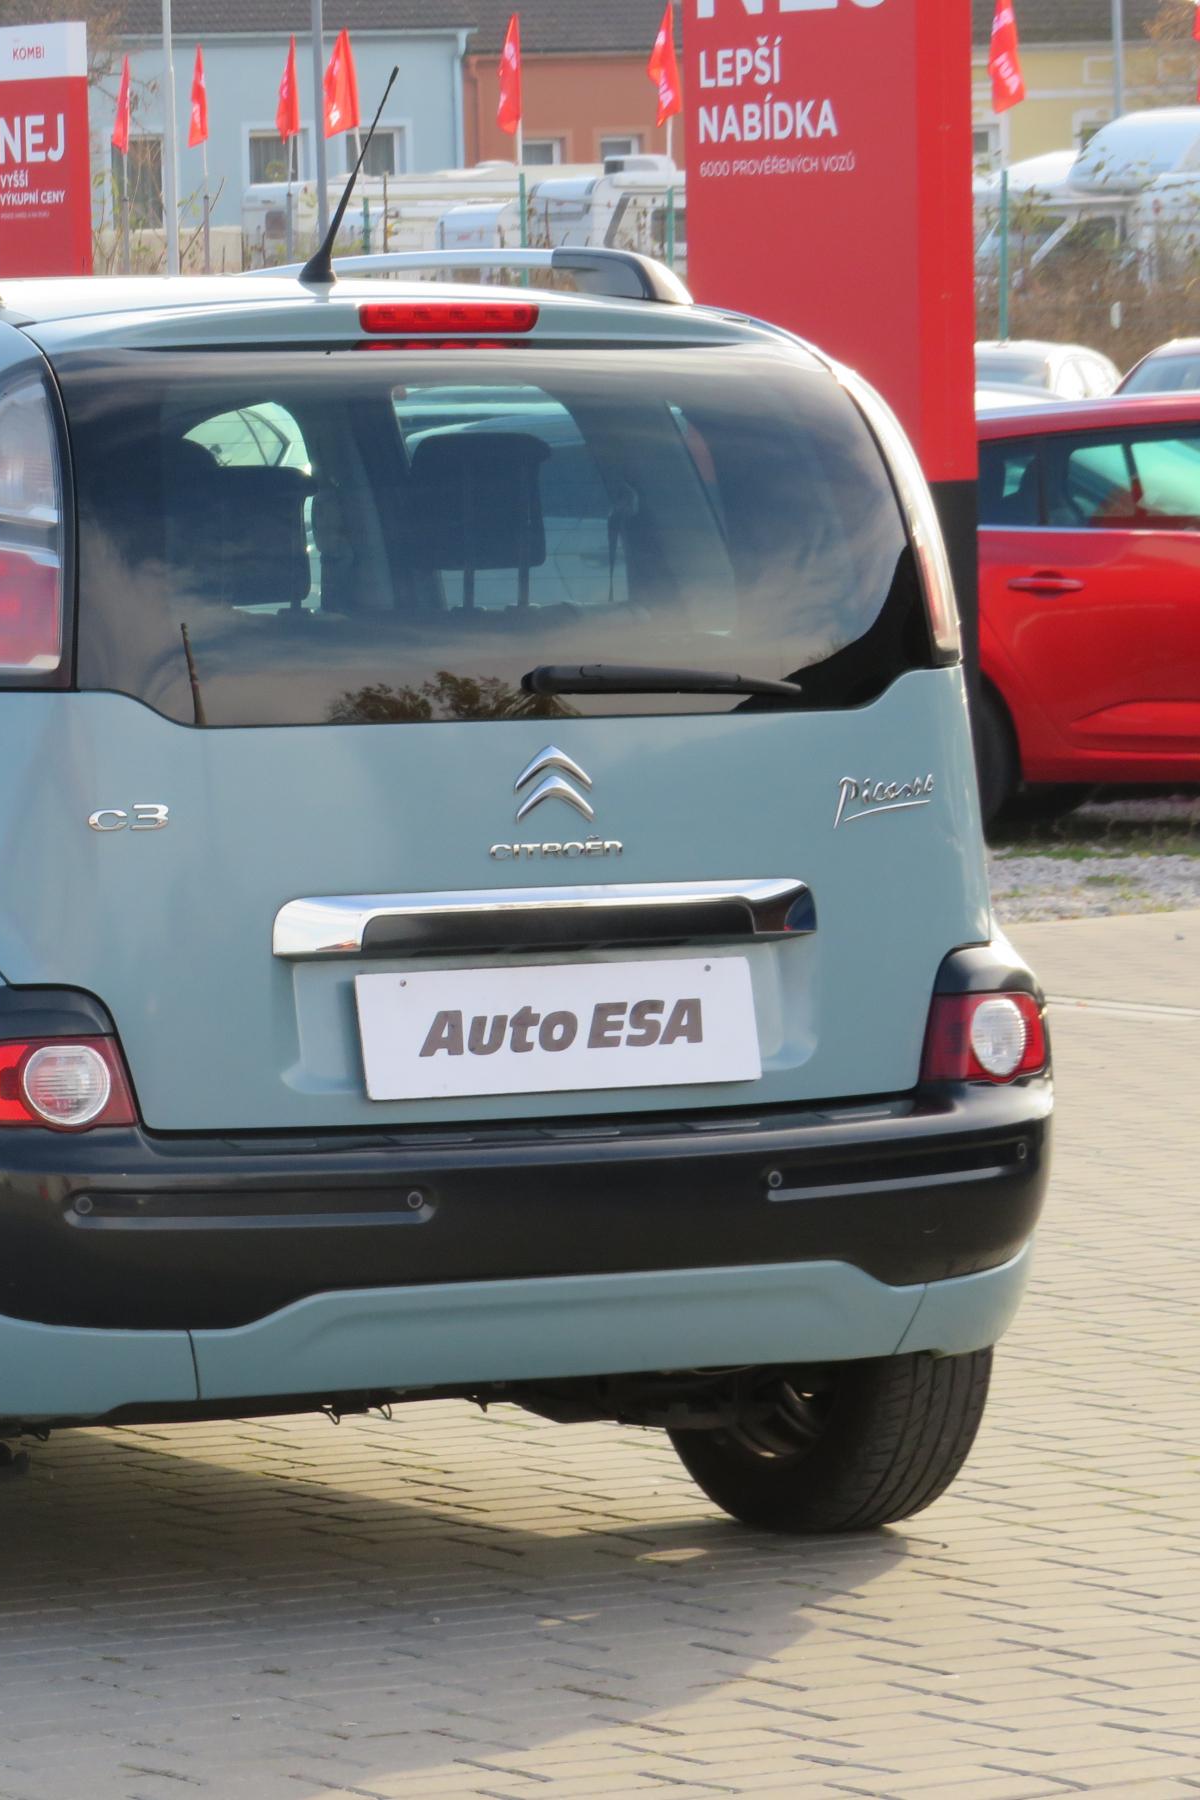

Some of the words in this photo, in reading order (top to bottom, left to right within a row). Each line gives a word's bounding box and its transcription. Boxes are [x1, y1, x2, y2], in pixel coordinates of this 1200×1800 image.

[12, 46, 45, 60] KOMBI
[699, 35, 782, 88] LEPŠÍ
[699, 93, 838, 143] NABÍDKA
[0, 169, 28, 188] VYŠŠÍ
[700, 160, 730, 177] 6000
[0, 189, 39, 206] VÝKUPNÍ
[40, 190, 65, 204] CENY
[833, 774, 935, 829] Picasso
[88, 804, 169, 832] C3
[419, 1006, 578, 1057] Auto
[587, 998, 703, 1048] ESA
